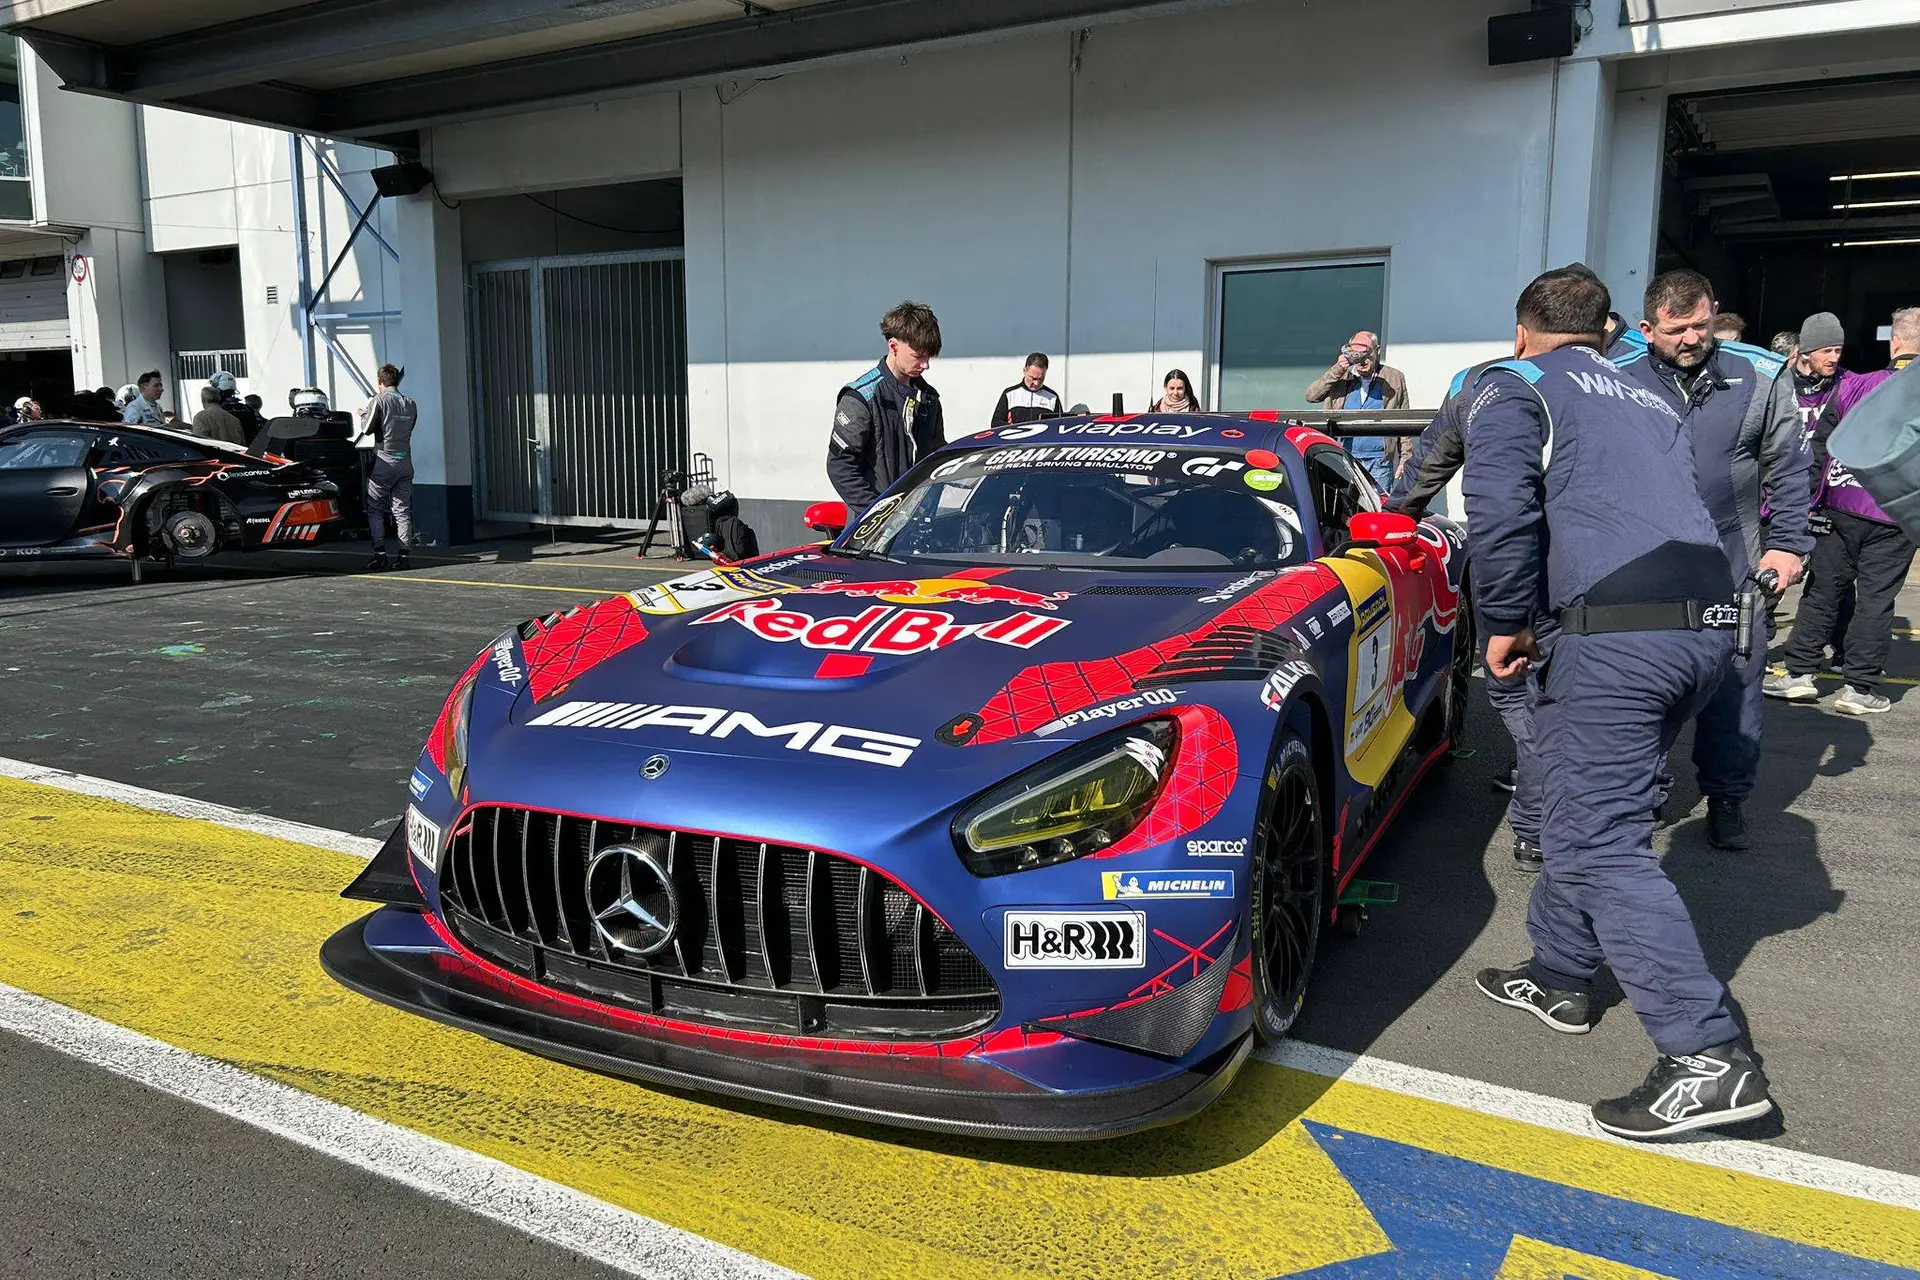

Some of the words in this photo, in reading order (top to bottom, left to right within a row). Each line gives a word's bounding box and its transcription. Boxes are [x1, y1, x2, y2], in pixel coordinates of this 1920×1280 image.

[1058, 422, 1213, 439] viaplay
[985, 447, 1053, 465] GRAN
[983, 463, 1002, 471] THE
[1005, 461, 1032, 470] REAL
[1035, 460, 1082, 468] DRIVING
[1084, 461, 1154, 471] SIMULATOR
[670, 582, 726, 591] 3
[687, 597, 897, 650] Red
[859, 608, 1073, 656] Bull
[1370, 635, 1379, 690] 3
[1186, 839, 1244, 858] sparco
[1148, 880, 1226, 891] MICHELIN
[1013, 922, 1087, 955] H&R
